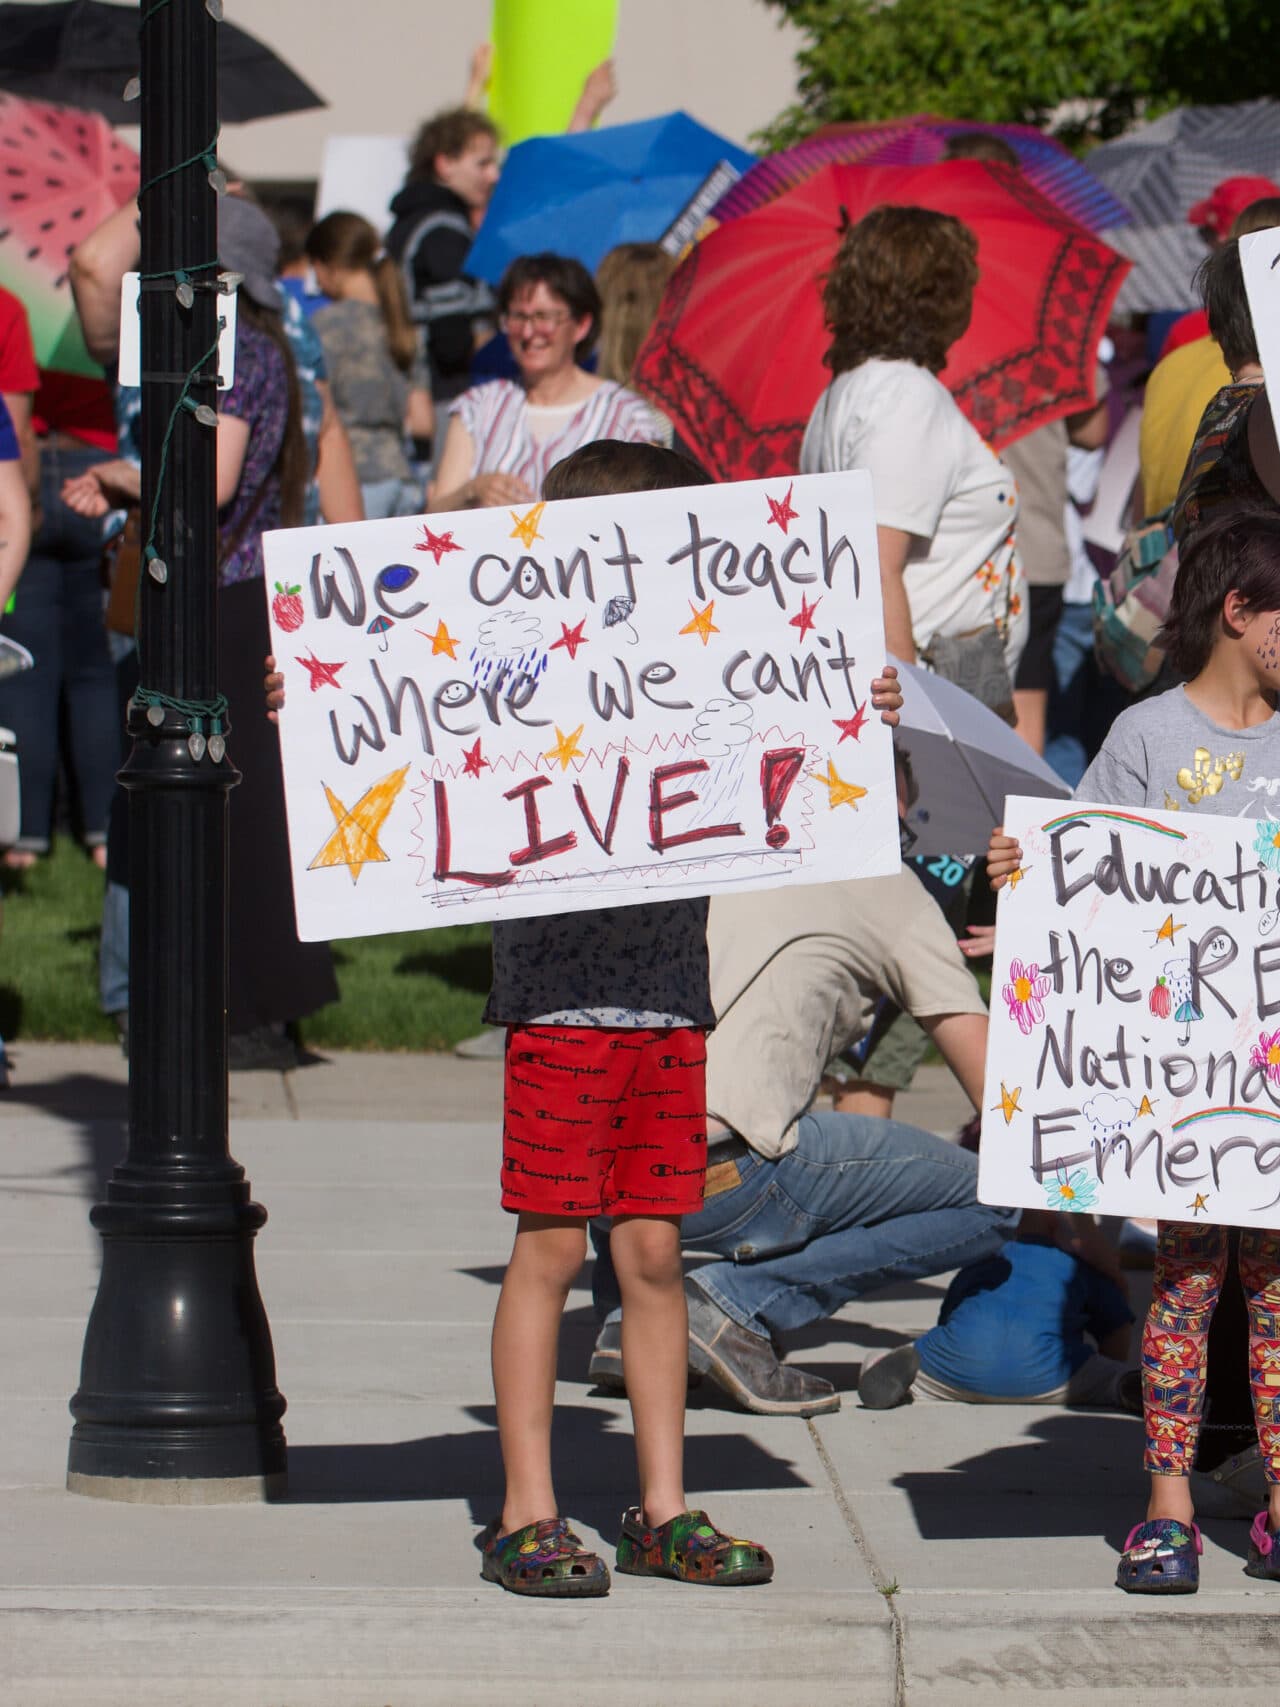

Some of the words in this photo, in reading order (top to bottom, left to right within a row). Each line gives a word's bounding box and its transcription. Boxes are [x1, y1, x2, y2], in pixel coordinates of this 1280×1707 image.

[310, 547, 429, 627] We
[470, 522, 643, 603] can't
[666, 505, 861, 610] teach
[329, 659, 553, 765] where
[589, 657, 695, 722] we
[722, 628, 858, 711] can't
[434, 746, 805, 887] LIVE!
[1039, 929, 1142, 1004] the
[518, 1052, 608, 1080] Champion
[504, 1157, 589, 1185] Champion
